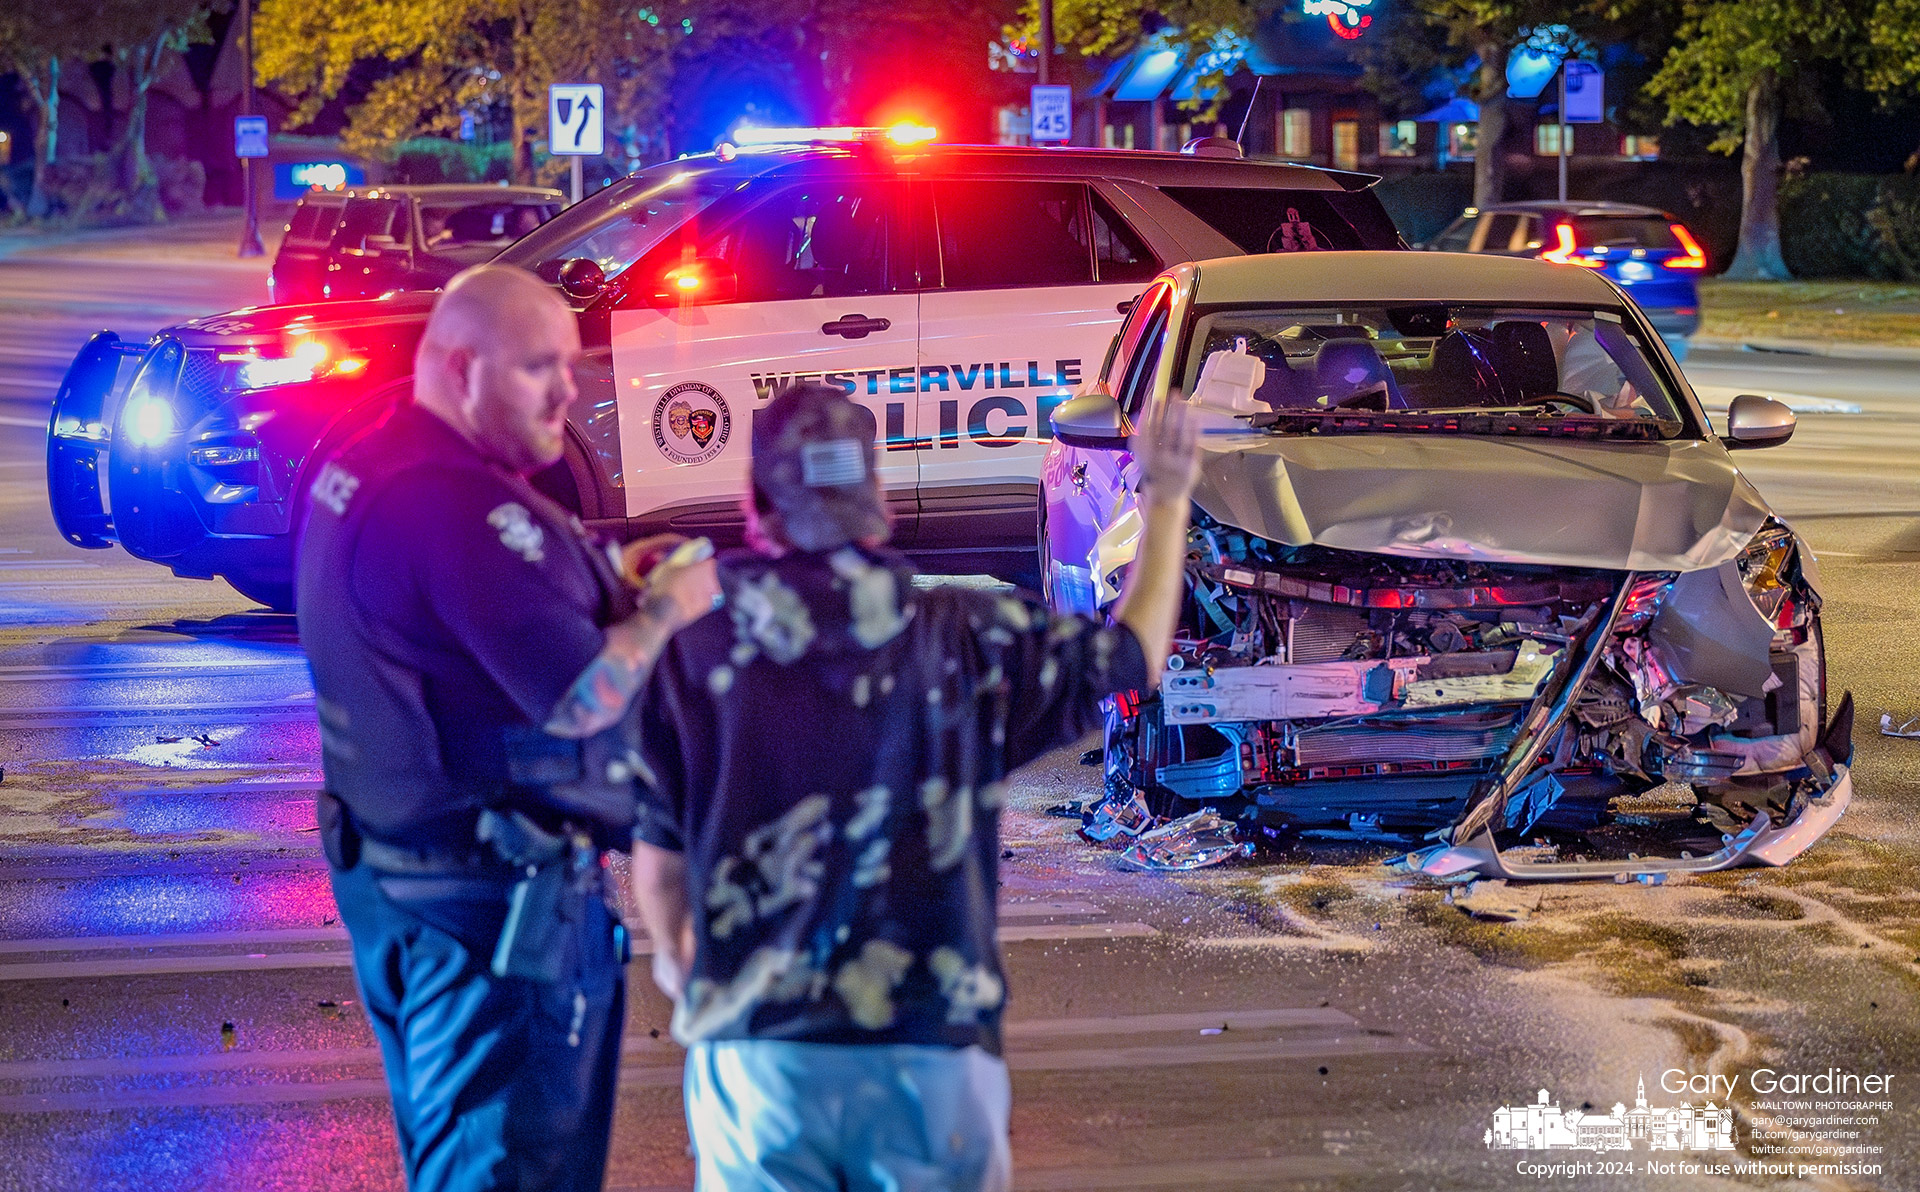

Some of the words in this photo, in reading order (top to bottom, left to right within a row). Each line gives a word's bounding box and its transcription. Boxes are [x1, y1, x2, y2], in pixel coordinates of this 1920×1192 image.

[1037, 114, 1066, 133] 45
[750, 358, 1083, 400] WESTERVILLE
[752, 393, 1073, 453] LIC
[669, 450, 703, 464] FOUNDED
